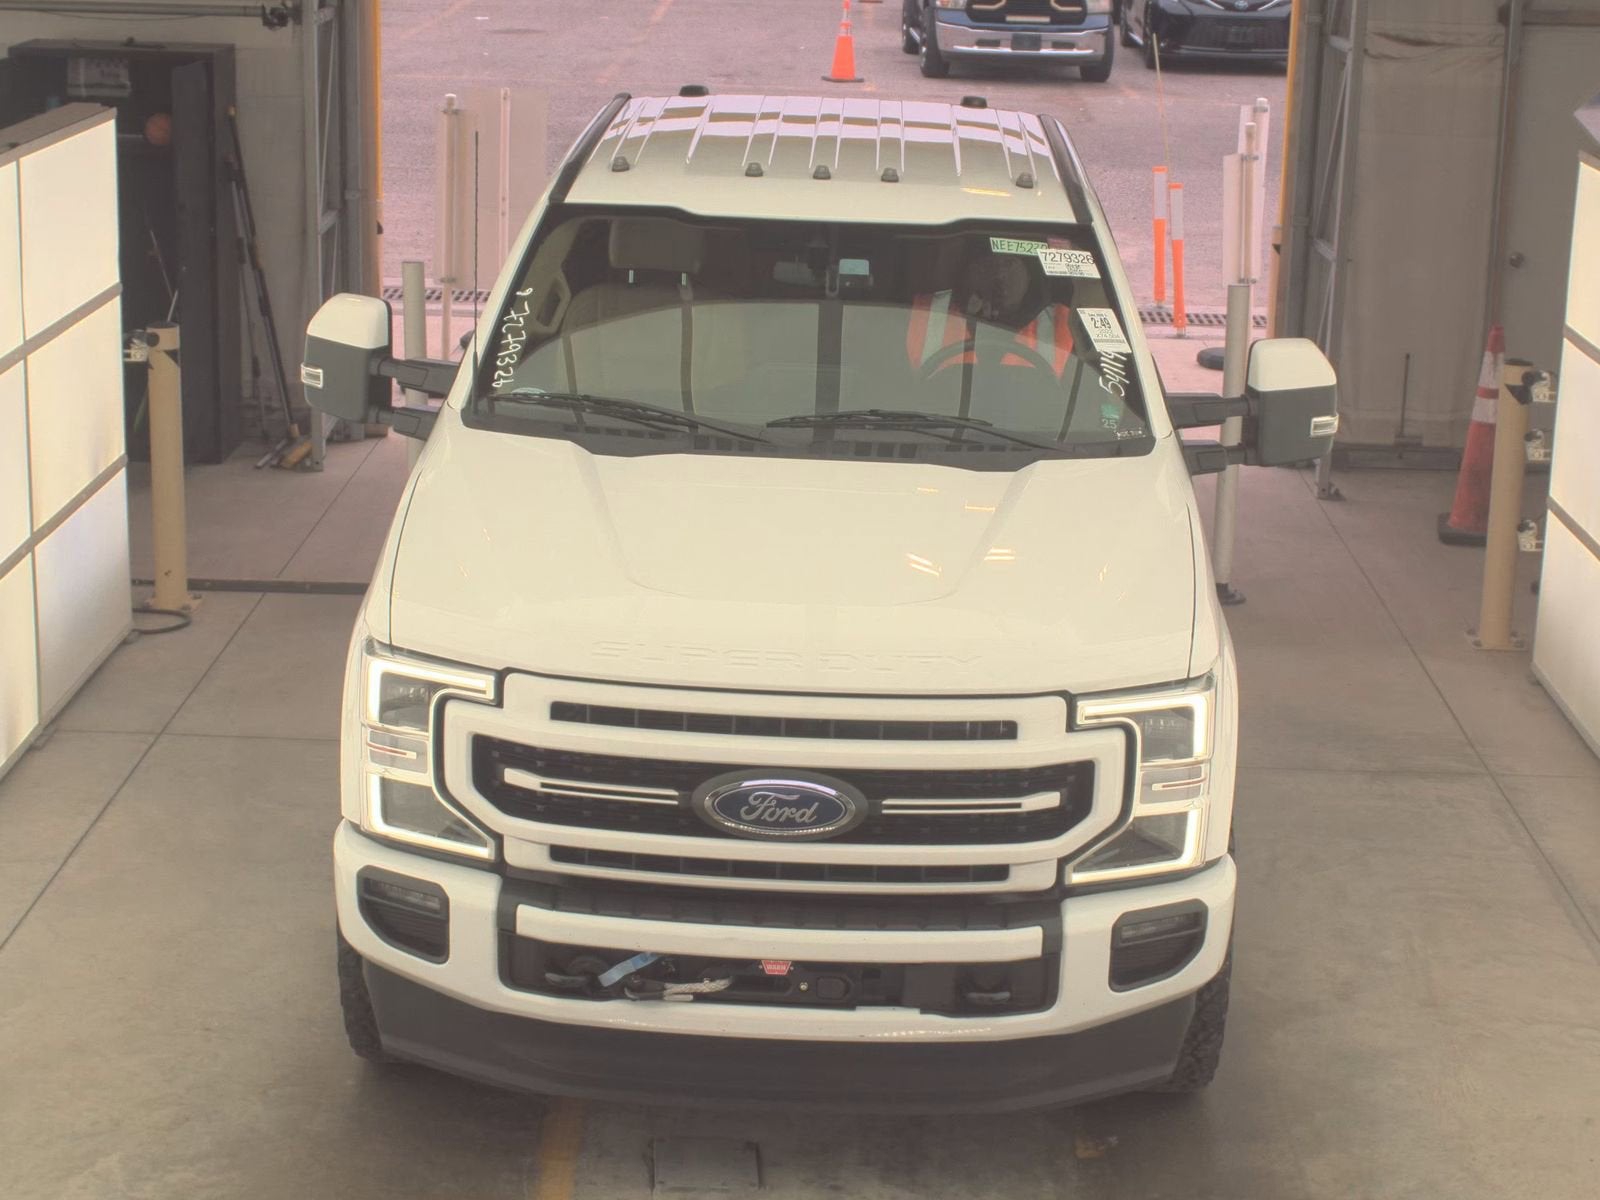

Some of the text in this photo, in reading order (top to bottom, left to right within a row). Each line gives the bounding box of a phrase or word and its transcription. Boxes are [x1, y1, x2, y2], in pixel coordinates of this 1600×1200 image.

[1041, 251, 1096, 265] 7279326
[1090, 316, 1112, 329] 2:49
[591, 640, 984, 673] SUPER DUTY
[740, 791, 818, 823] Ford
